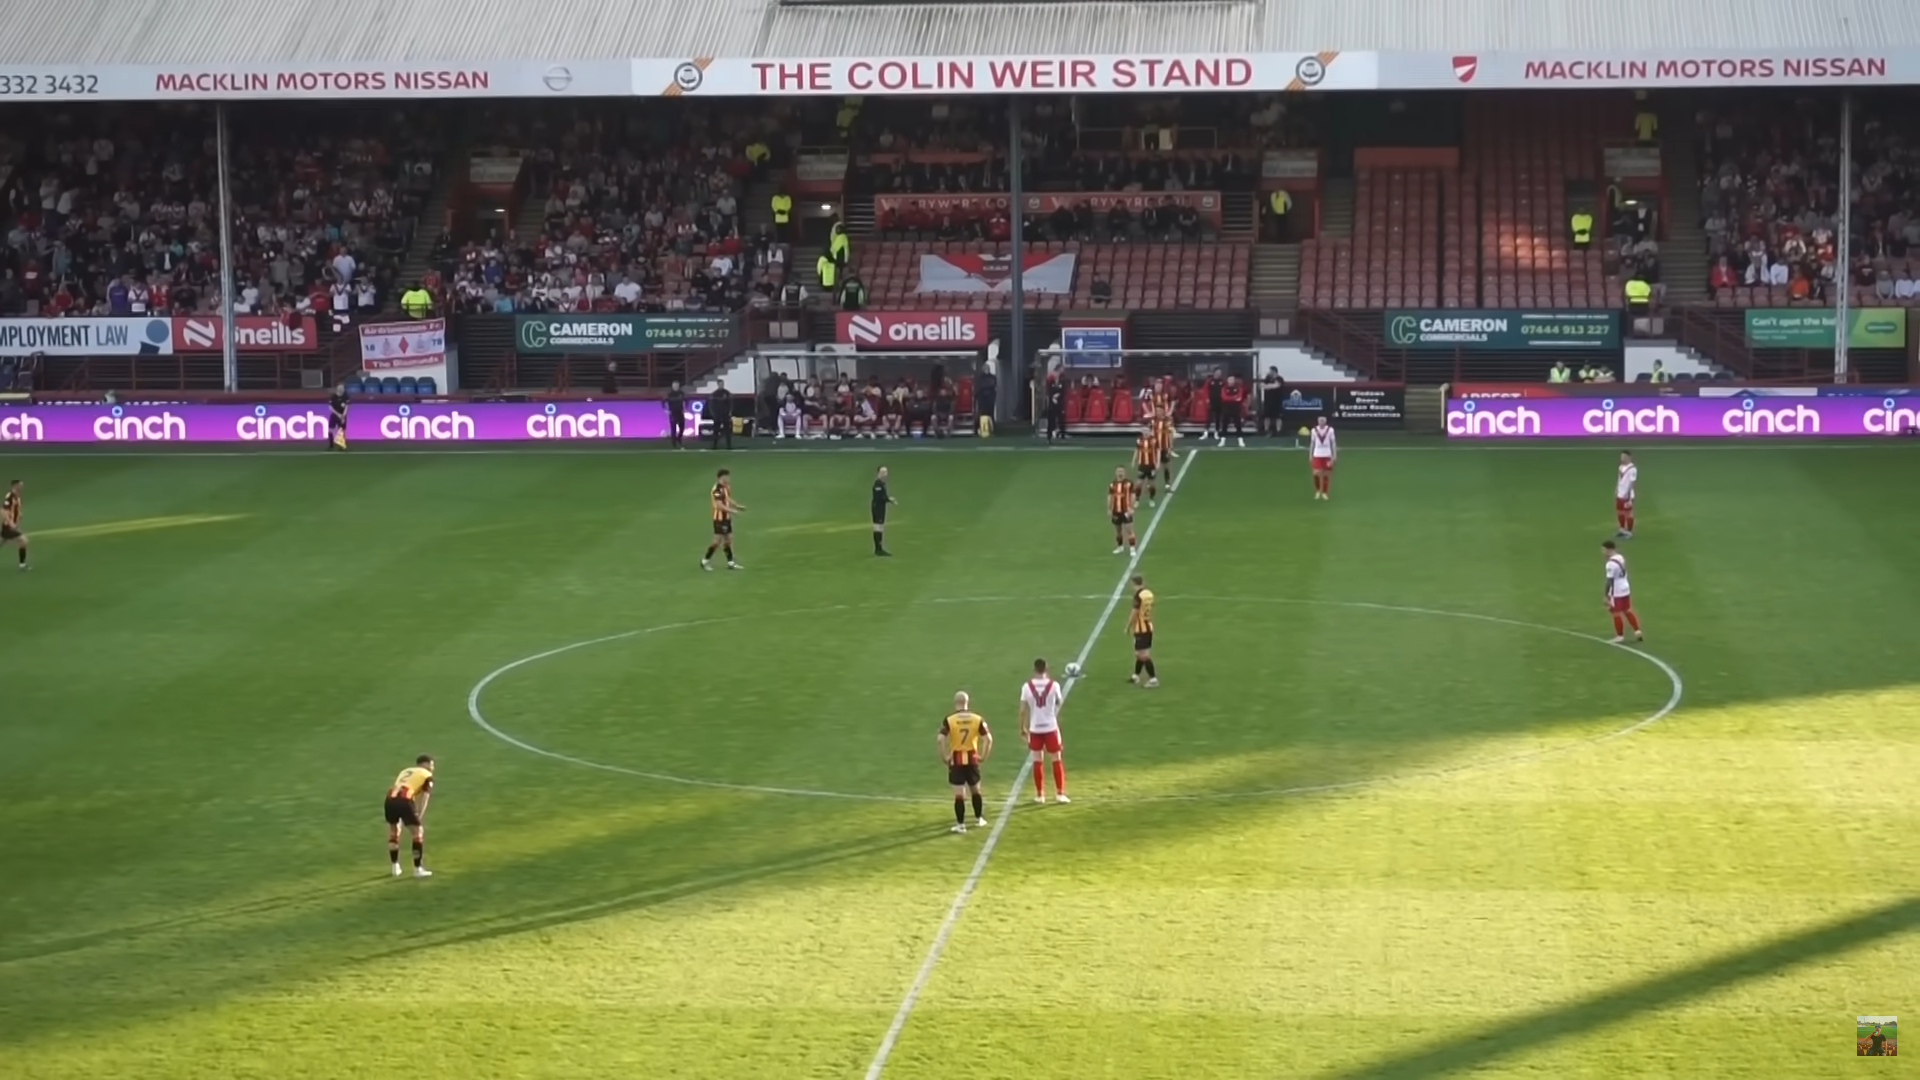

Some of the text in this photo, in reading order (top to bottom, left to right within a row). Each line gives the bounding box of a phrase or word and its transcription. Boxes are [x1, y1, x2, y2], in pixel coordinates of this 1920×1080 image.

[751, 58, 1253, 91] THE COLIN WEIR STAND
[1523, 57, 1887, 80] MACKLIN MOTORS NISSAN
[44, 74, 99, 94] 3432
[155, 71, 490, 92] MACKLIN MOTORS NISSAN
[549, 323, 633, 336] CAMERON
[645, 328, 683, 338] 07444
[1419, 318, 1508, 332] CAMERON
[1521, 324, 1610, 335] 07444 913 227
[1752, 317, 1777, 326] Can't
[1779, 317, 1801, 328] spot
[1803, 317, 1820, 326] the
[96, 325, 128, 347] LAW
[549, 337, 615, 345] COMMERCIALS
[1419, 333, 1489, 342] COMMERCIALS
[93, 405, 186, 440] cinch
[236, 404, 329, 440] cinch
[380, 404, 475, 440] cinch
[526, 402, 621, 438] cinch
[1447, 400, 1541, 434] cinch
[1583, 399, 1680, 434] cinch
[1722, 398, 1820, 433] cinch
[1863, 397, 1920, 433] cin
[959, 728, 970, 745] 7
